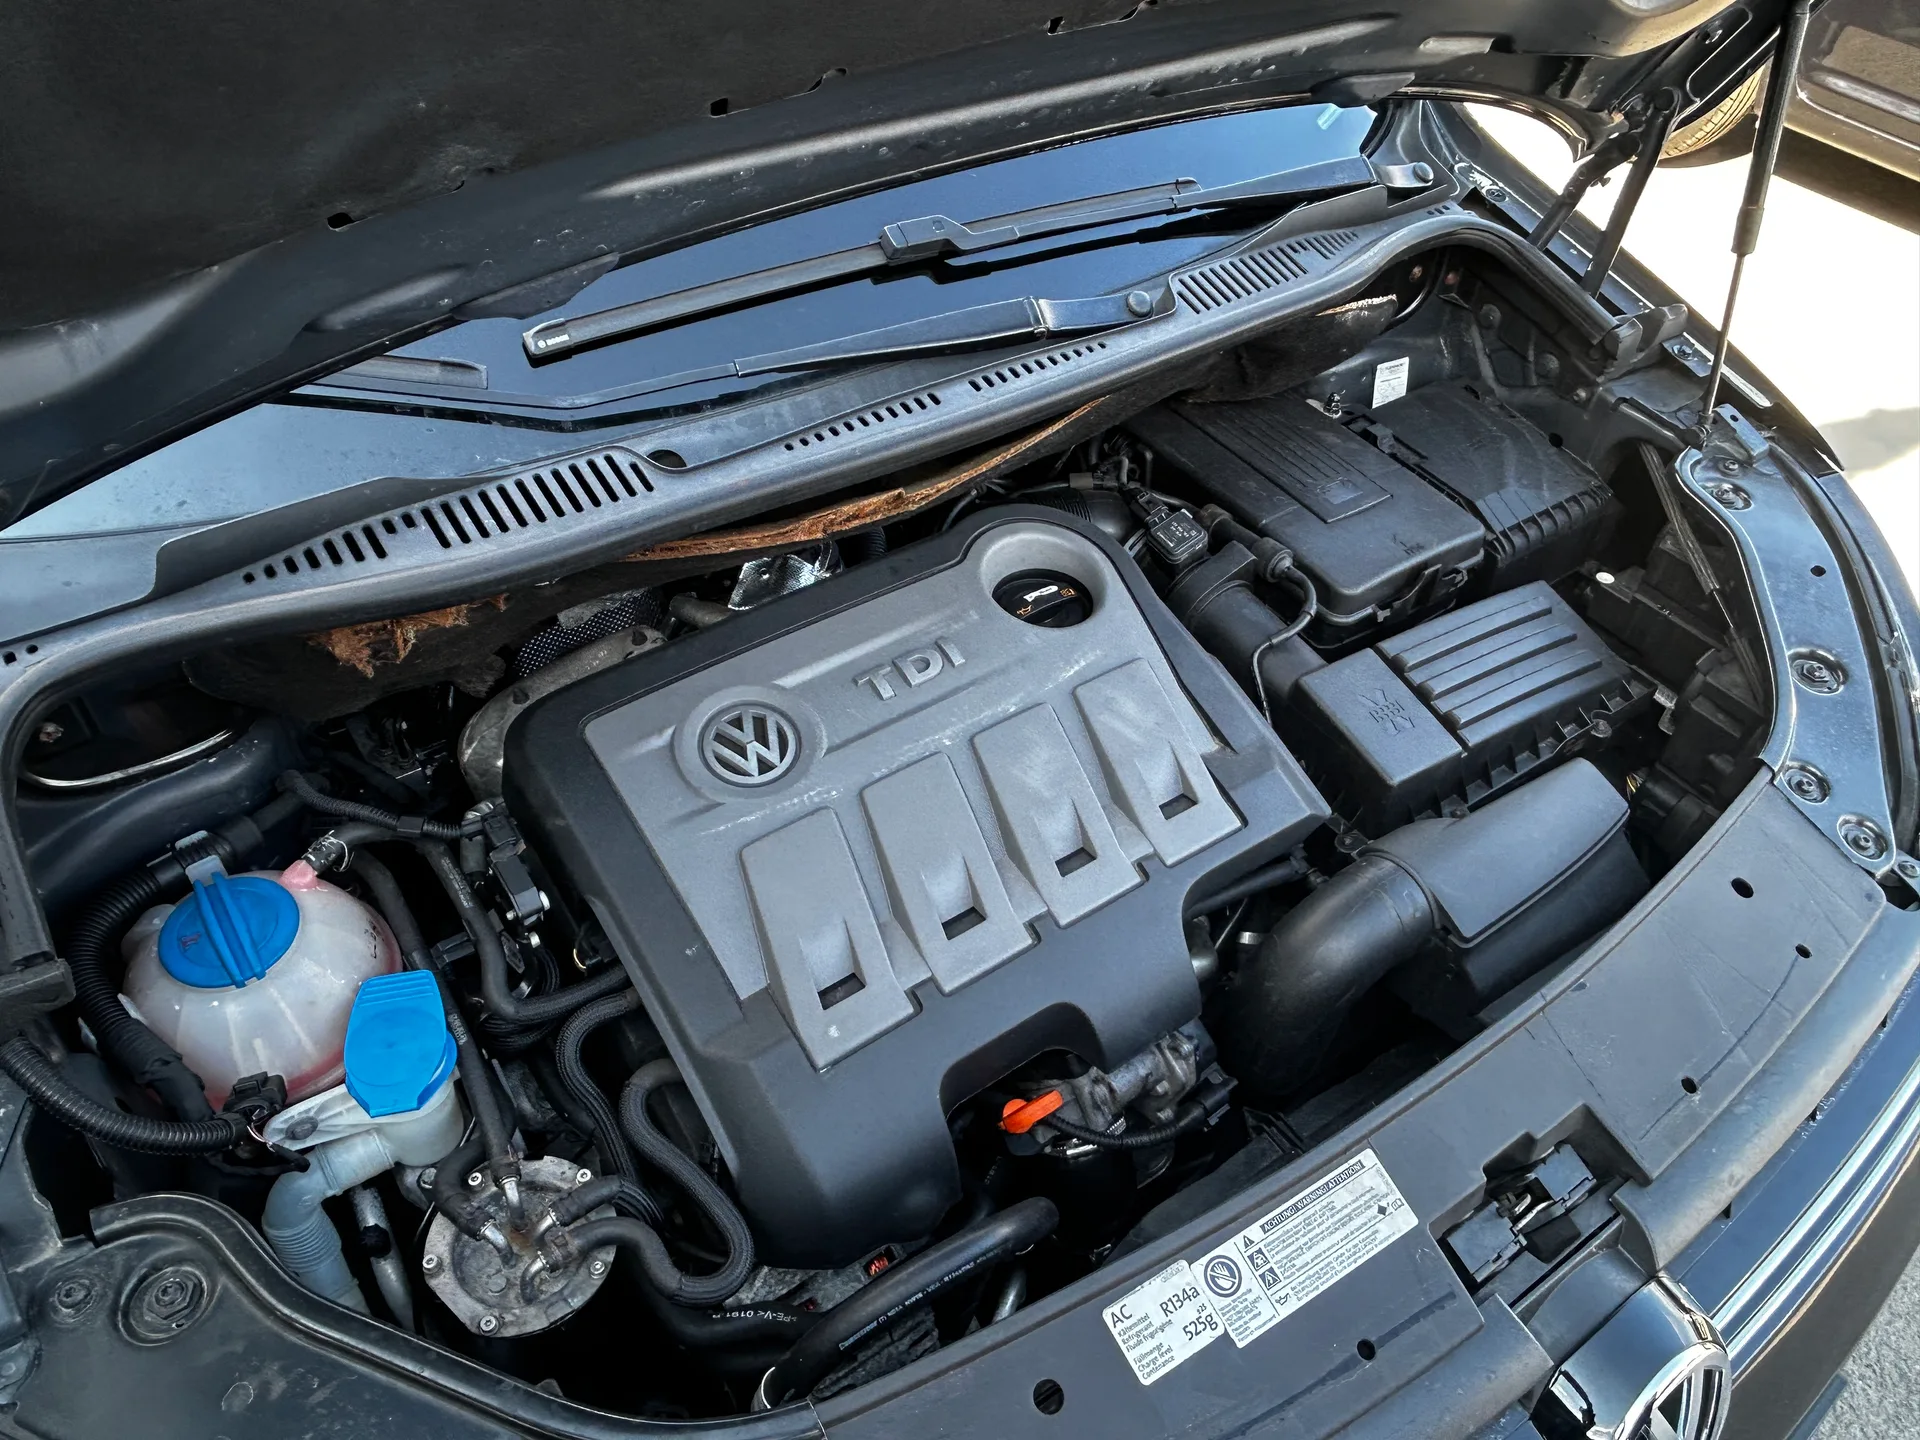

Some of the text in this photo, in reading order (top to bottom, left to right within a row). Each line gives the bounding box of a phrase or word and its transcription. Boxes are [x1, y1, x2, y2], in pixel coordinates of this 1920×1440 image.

[853, 638, 966, 701] TDI
[703, 708, 798, 782] VW
[1111, 1304, 1132, 1328] AC
[1160, 1287, 1200, 1317] R134a
[1183, 1313, 1218, 1340] 525g
[1138, 1345, 1173, 1372] Charge level
